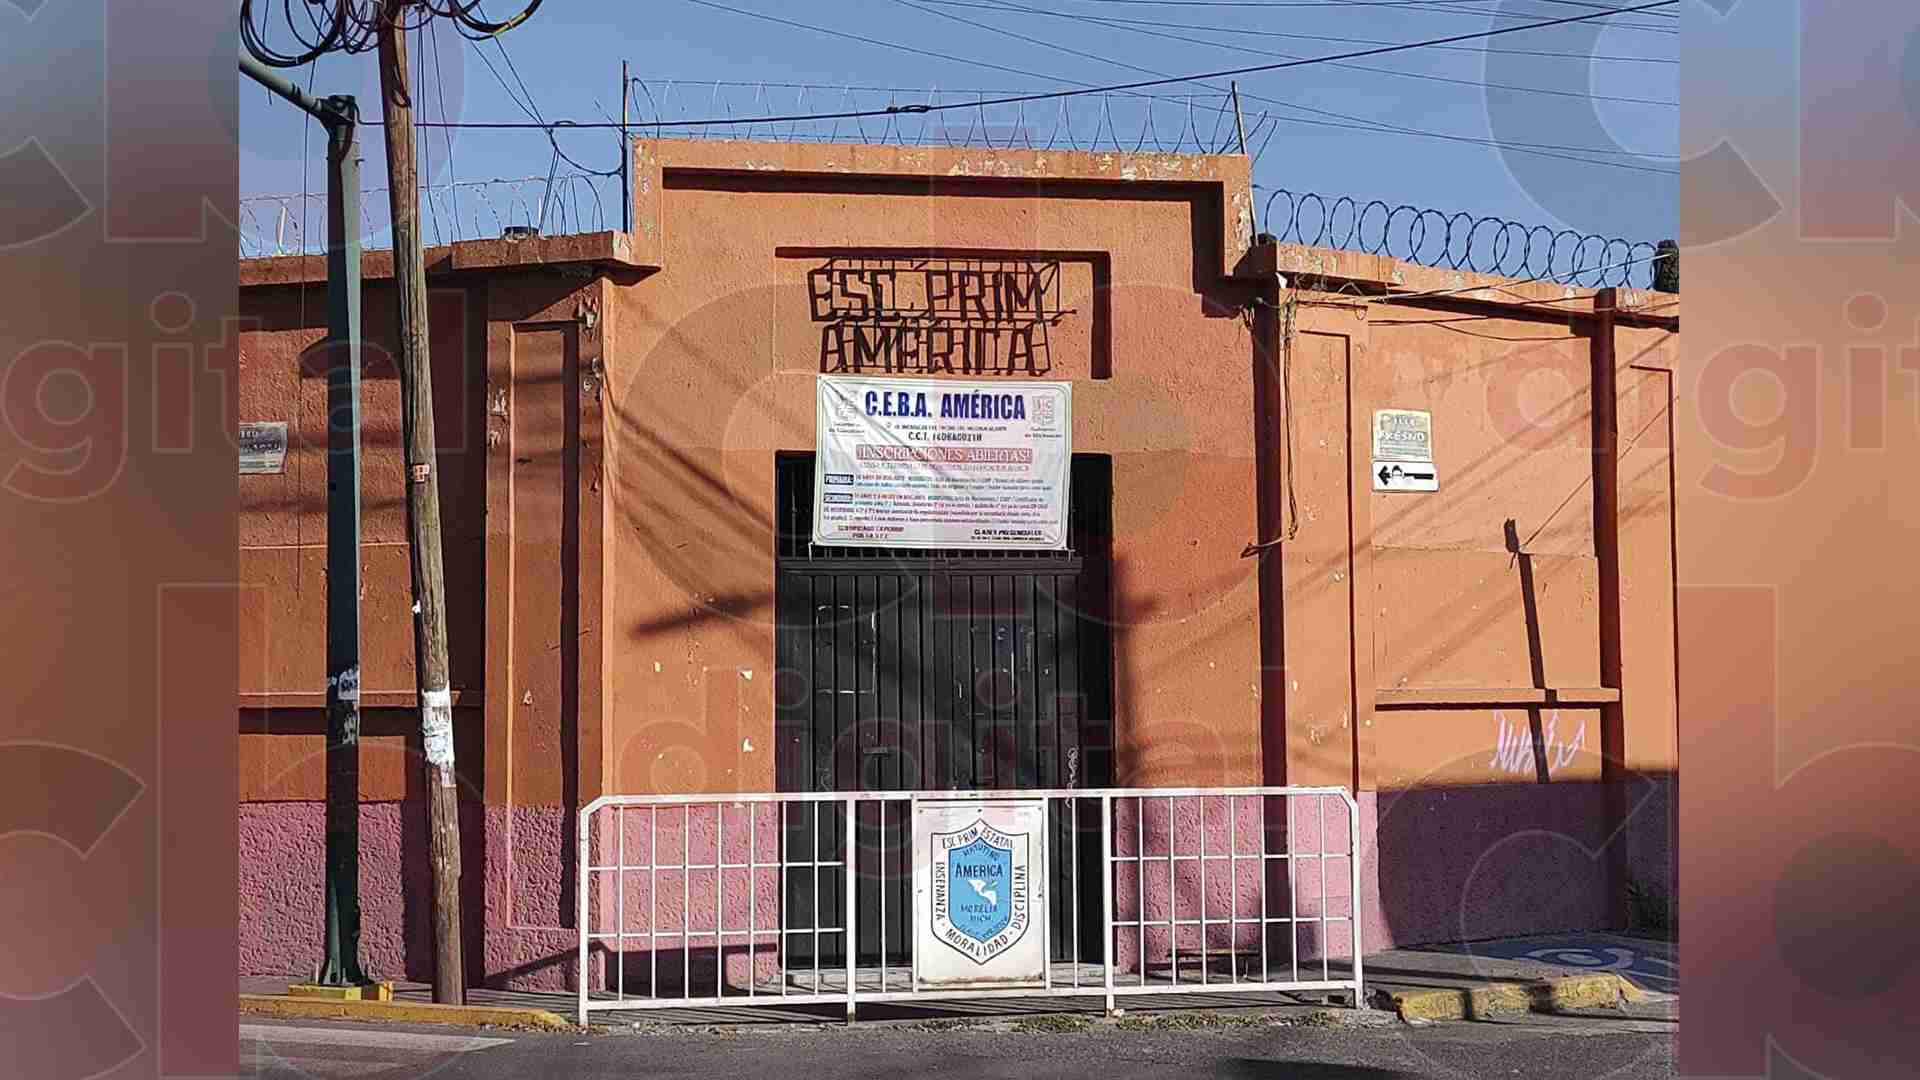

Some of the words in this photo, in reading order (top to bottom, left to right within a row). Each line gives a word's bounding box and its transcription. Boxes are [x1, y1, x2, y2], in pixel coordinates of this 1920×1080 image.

[865, 390, 932, 417] C.E.B.A.
[940, 388, 1026, 420] AMÉRICA
[980, 827, 1014, 850] ESTATAL
[955, 863, 1003, 878] AMERICA
[1011, 864, 1026, 930] DISCIPLINA
[945, 928, 1009, 956] MORALIDAD
